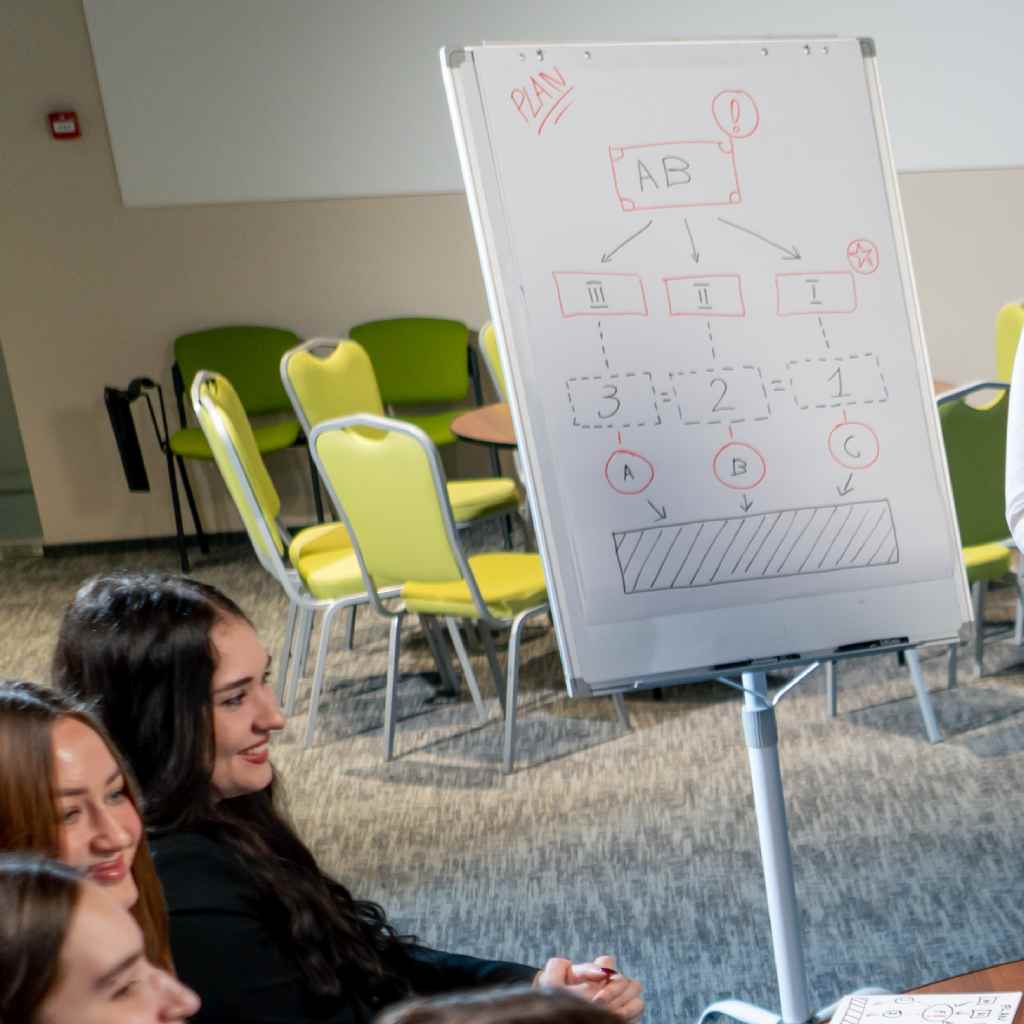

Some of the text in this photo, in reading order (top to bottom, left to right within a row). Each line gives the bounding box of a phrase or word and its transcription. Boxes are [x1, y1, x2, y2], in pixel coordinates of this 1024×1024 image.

[510, 65, 567, 123] PLAN
[637, 155, 692, 192] AB
[586, 281, 609, 309] III
[693, 283, 713, 310] II
[597, 383, 622, 420] 3
[709, 376, 736, 413] 2
[826, 366, 852, 399] 1
[842, 435, 861, 459] C
[623, 463, 635, 482] A
[730, 458, 749, 477] B
